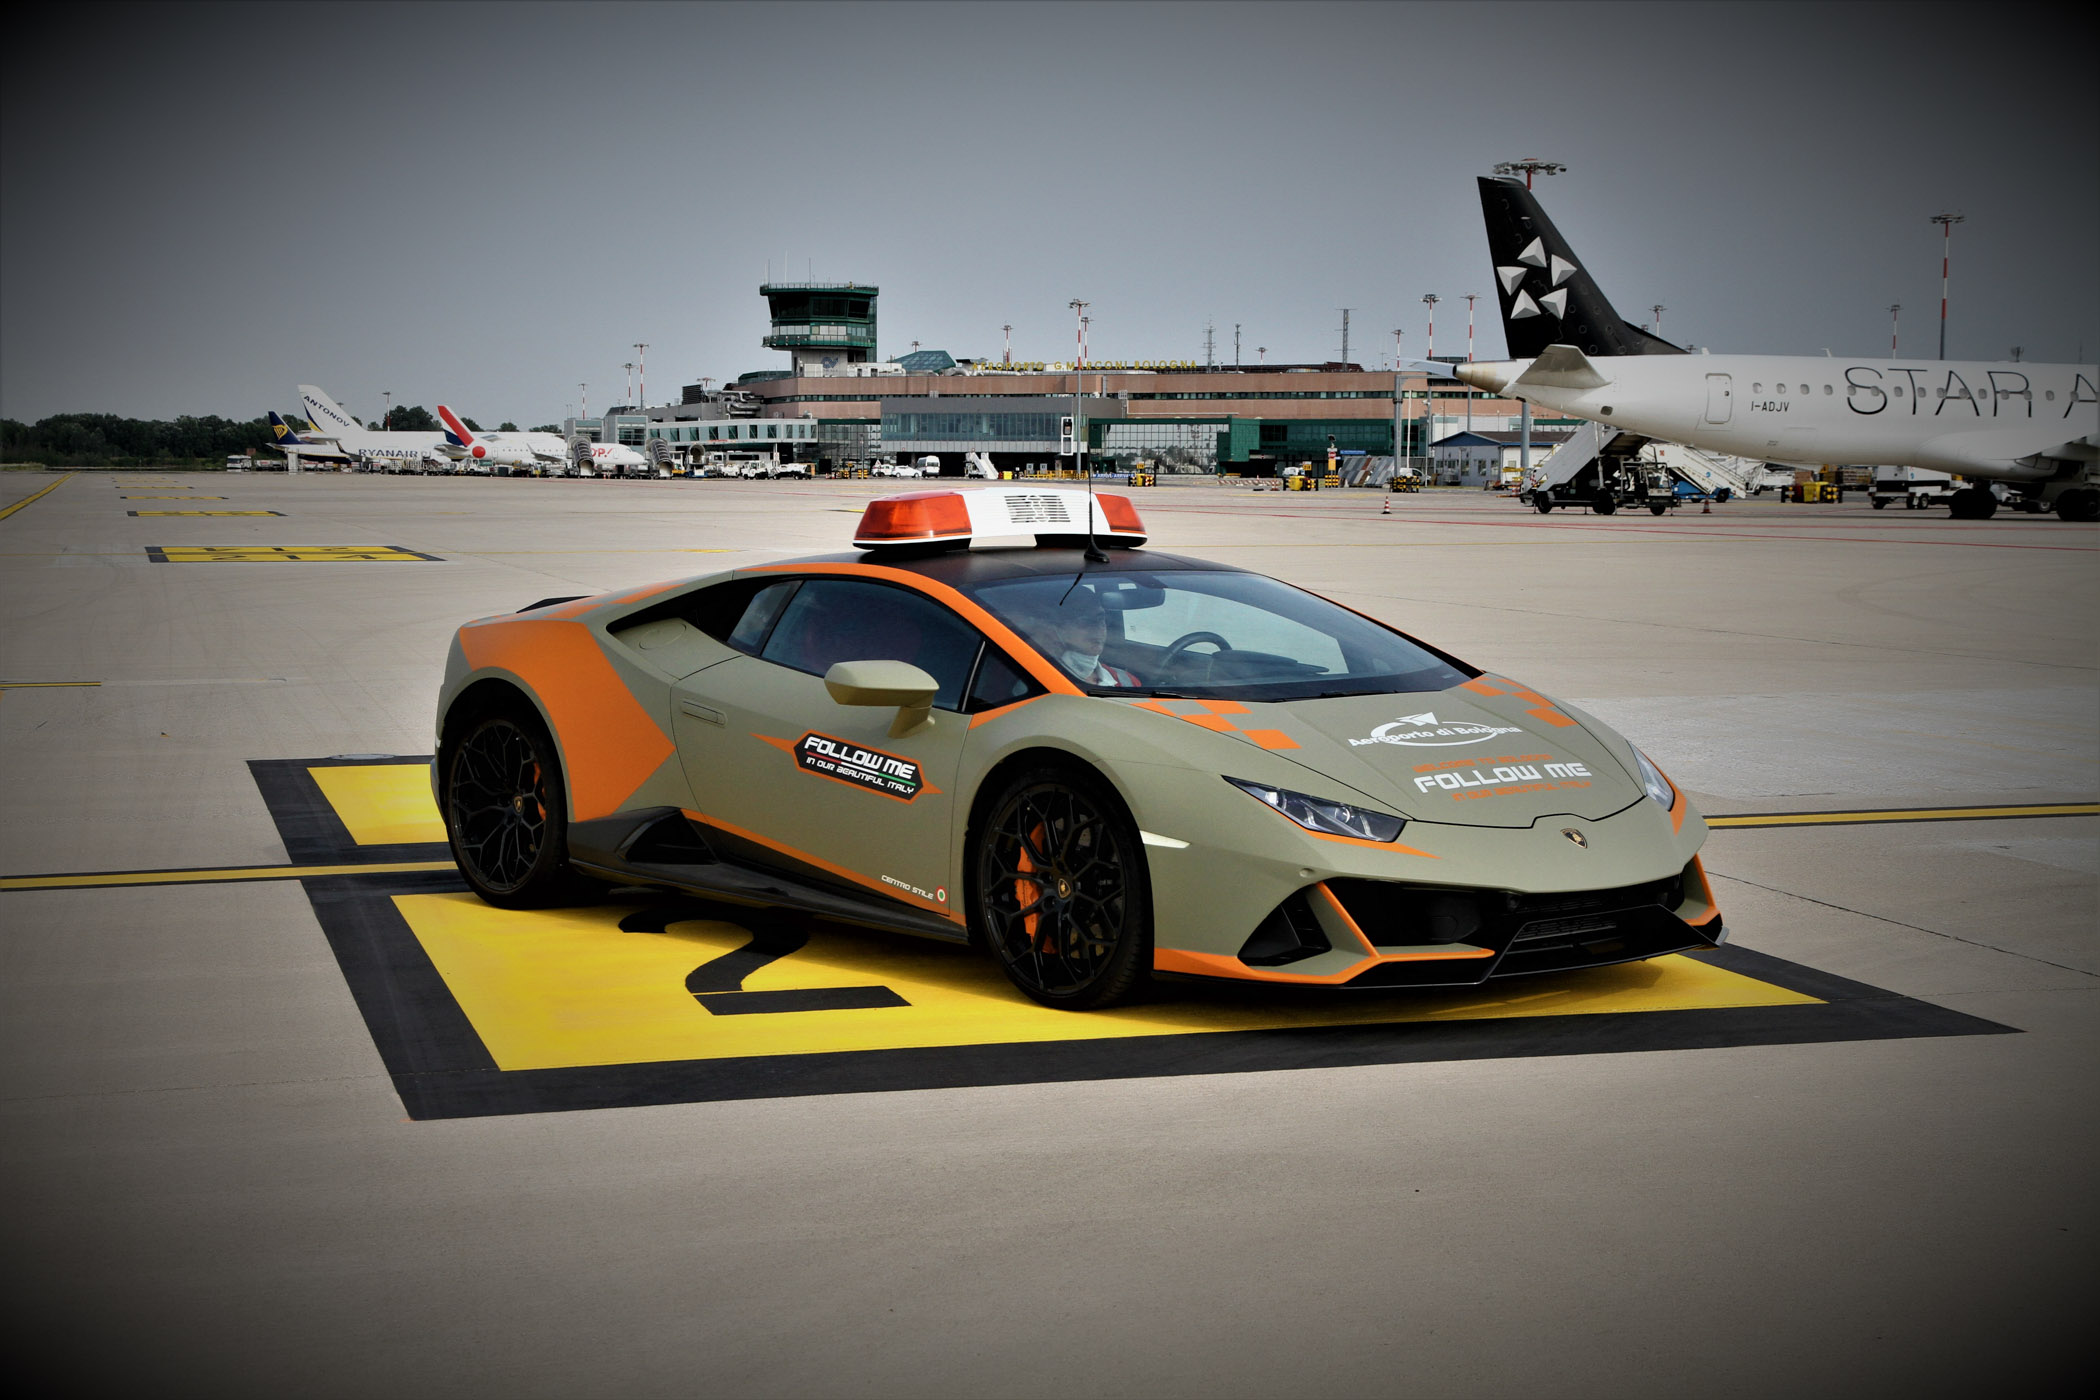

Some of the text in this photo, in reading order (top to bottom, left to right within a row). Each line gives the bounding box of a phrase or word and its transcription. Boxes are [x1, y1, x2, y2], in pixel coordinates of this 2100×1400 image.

[971, 362, 1044, 371] AEROPORTO
[1133, 360, 1197, 370] BOLOGNA
[1844, 366, 2033, 418] STAR
[303, 395, 350, 428] ANTONOV
[1751, 401, 1790, 413] I-ADJV
[358, 448, 418, 458] RYANAIR
[590, 447, 613, 458] OP!
[1348, 726, 1523, 747] Aeroporto di Bologna
[804, 736, 916, 780] FOLLOW ME
[1413, 754, 1553, 773] WELCOME TO BOLOGNA
[806, 756, 915, 794] IN OUR BEAUTIFUL ITALY
[1413, 762, 1593, 794] FOLLOW ME
[1451, 780, 1592, 802] IN OUR BEAUTIFUL ITALY
[881, 874, 934, 900] CENTRO STILE
